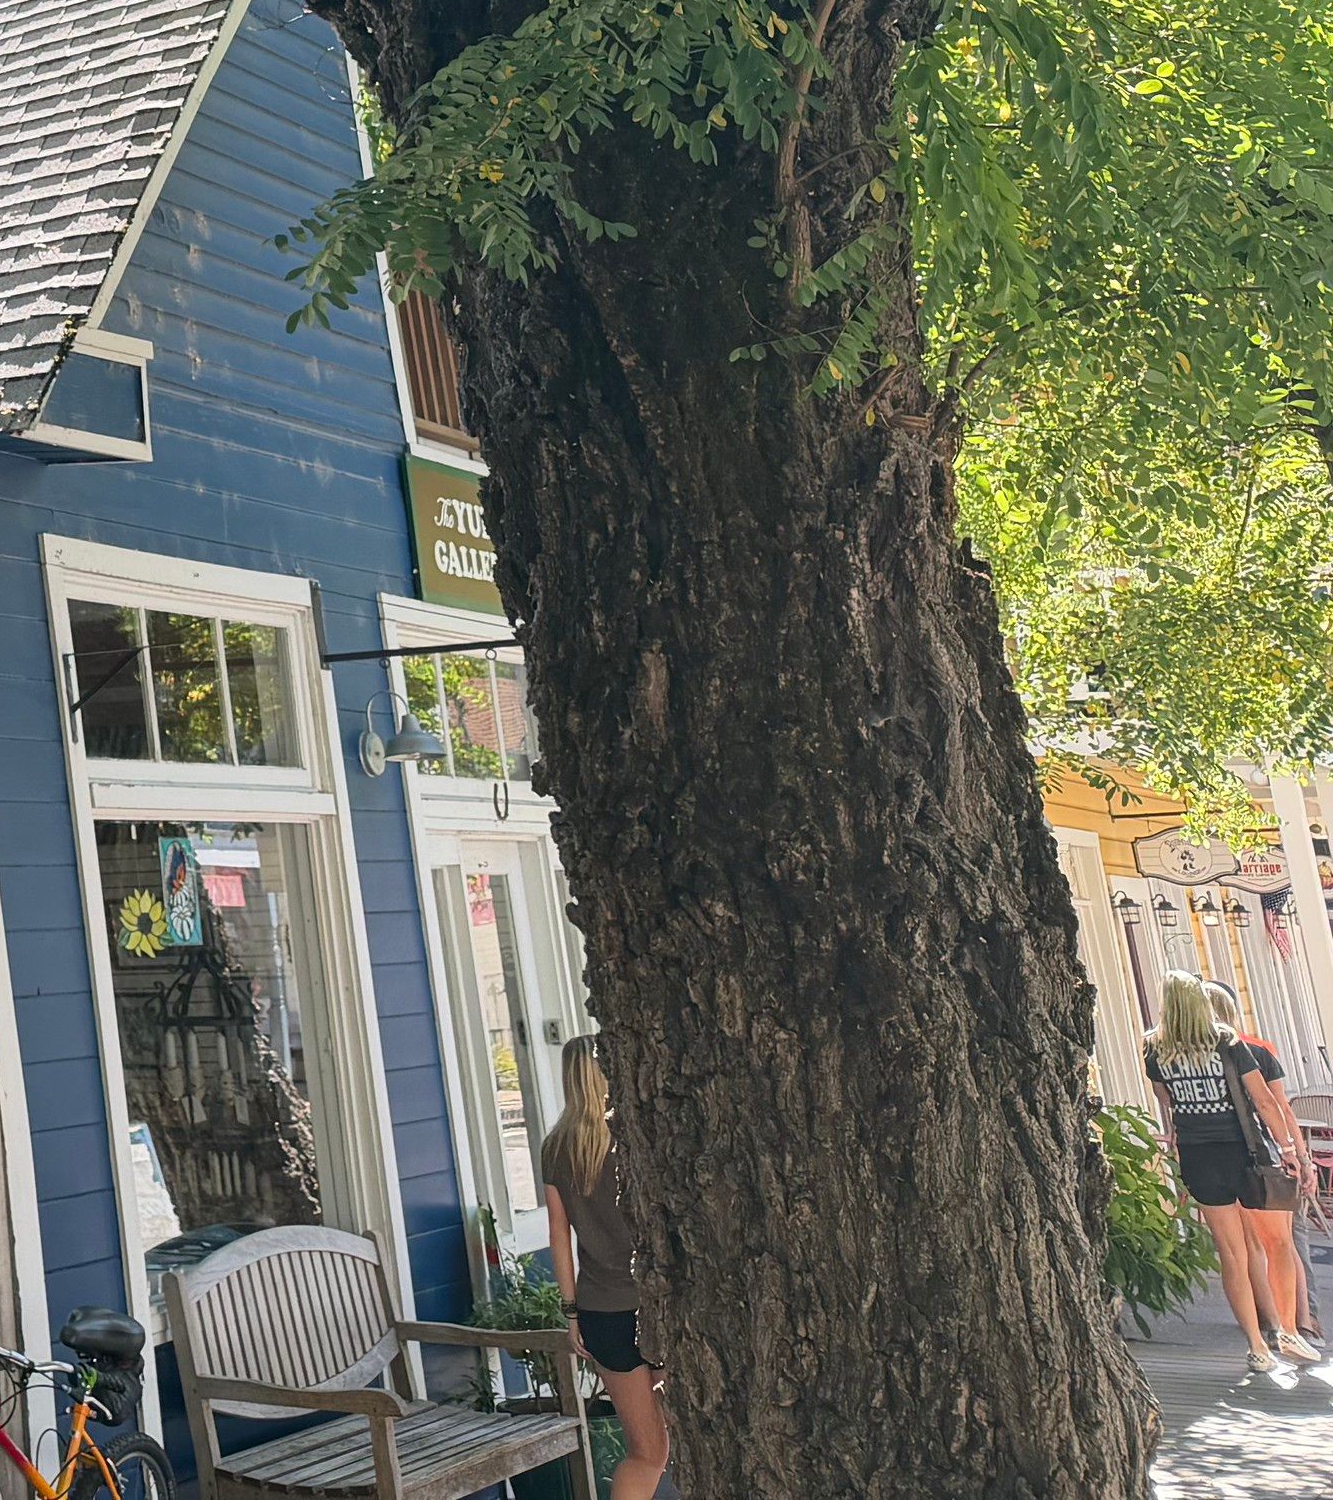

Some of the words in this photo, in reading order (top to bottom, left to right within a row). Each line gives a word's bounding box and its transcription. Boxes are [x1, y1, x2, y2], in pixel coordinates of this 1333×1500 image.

[434, 497, 454, 528] The
[1240, 863, 1282, 875] arriage
[1172, 1077, 1221, 1102] CREW
